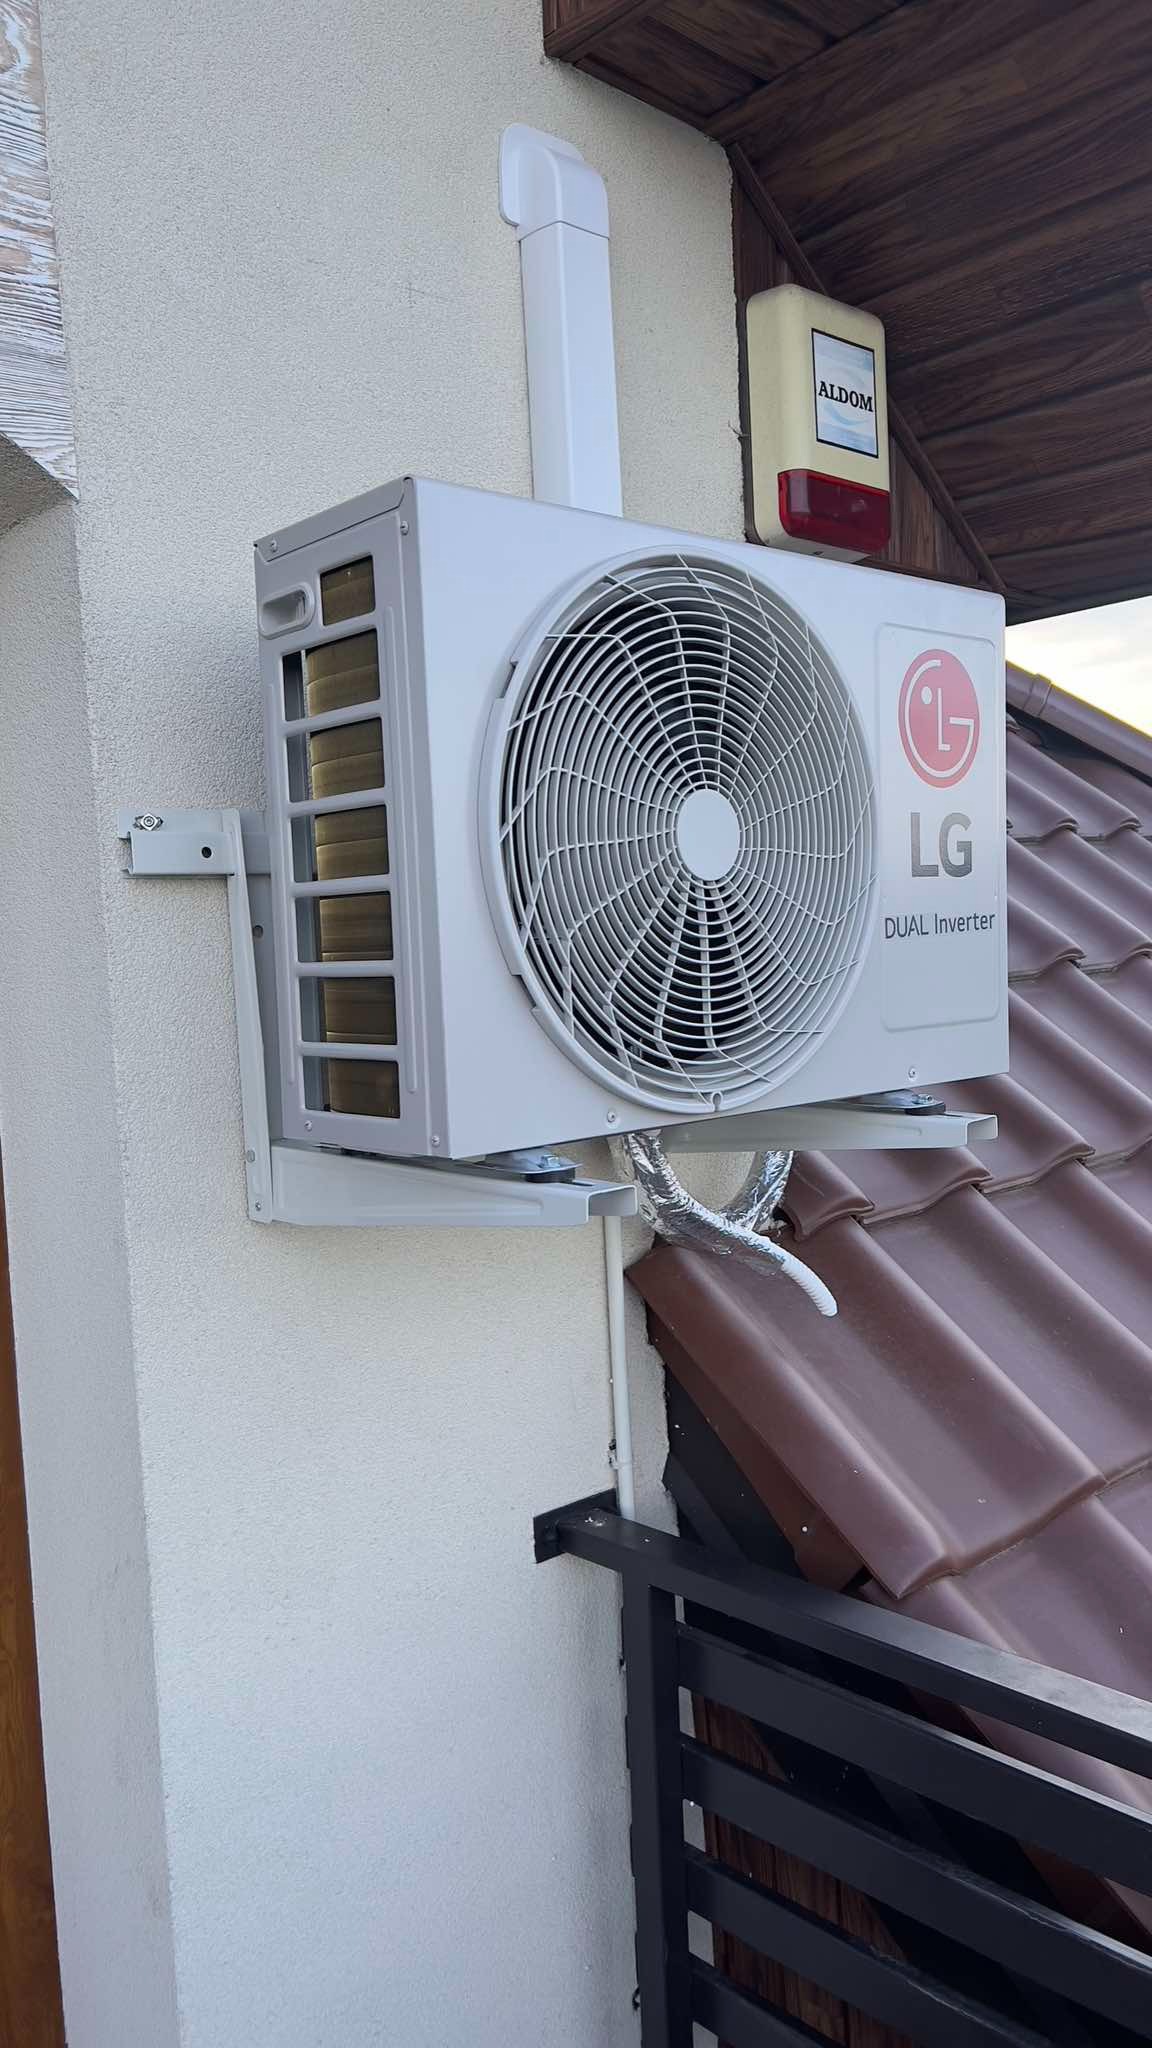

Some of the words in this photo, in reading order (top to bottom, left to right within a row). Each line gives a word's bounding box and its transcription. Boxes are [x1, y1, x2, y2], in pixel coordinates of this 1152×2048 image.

[818, 381, 873, 412] ALDOM
[910, 812, 972, 878] LG
[884, 914, 929, 939] DUAL
[934, 912, 995, 934] Inverter
